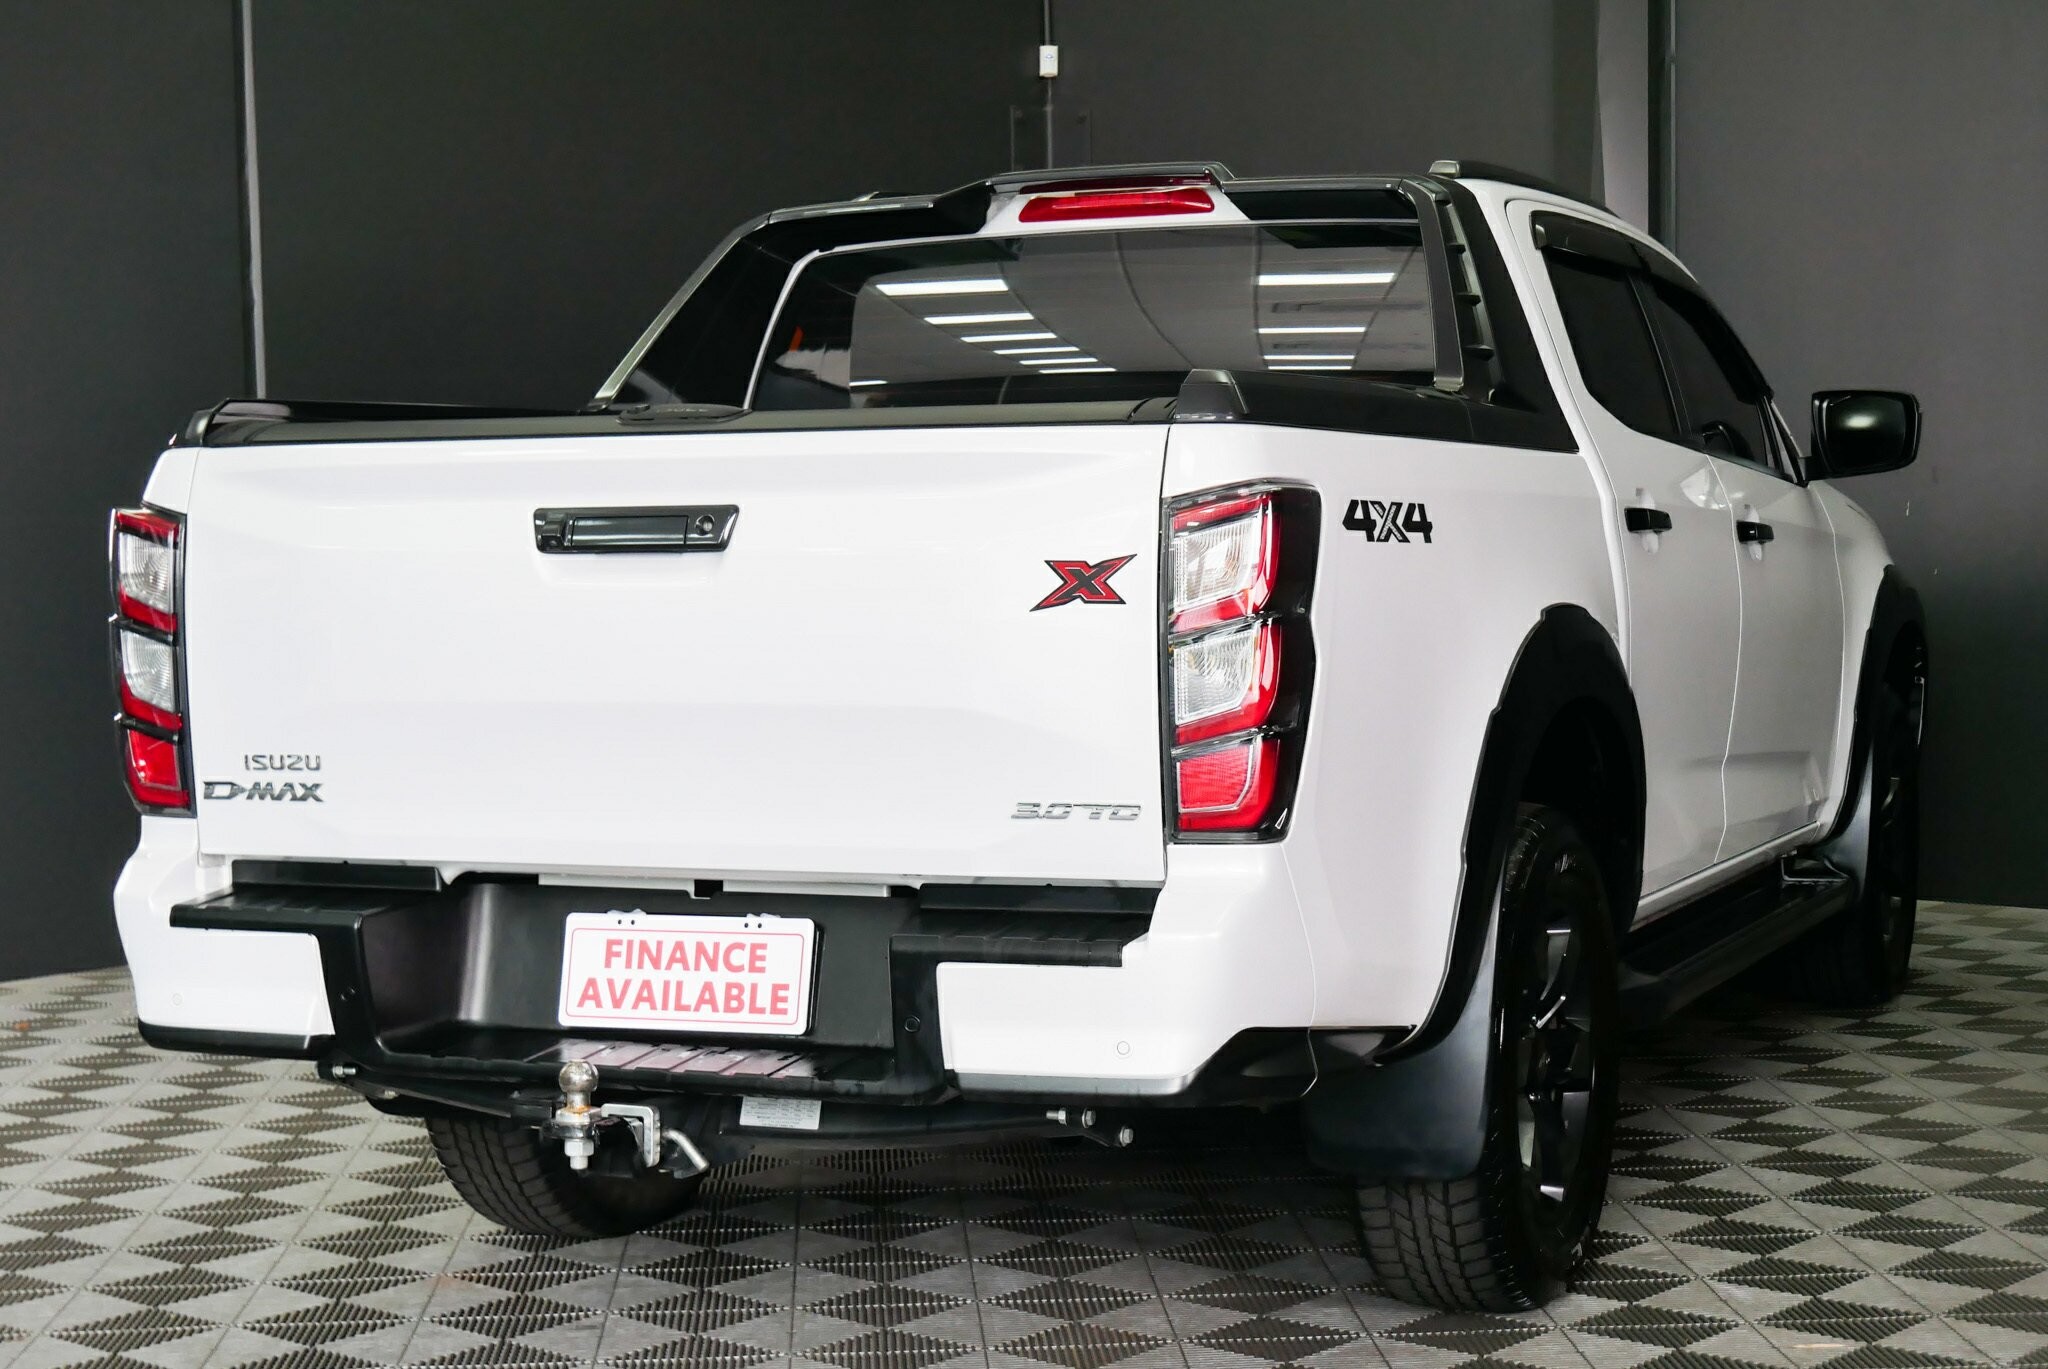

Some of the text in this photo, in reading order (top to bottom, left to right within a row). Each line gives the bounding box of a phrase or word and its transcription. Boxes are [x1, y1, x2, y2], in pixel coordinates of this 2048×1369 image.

[1030, 553, 1138, 612] X
[244, 754, 321, 771] ISUZU
[203, 781, 324, 802] D-MAX
[604, 939, 768, 974] FINANCE
[576, 977, 790, 1016] AVAILABLE
